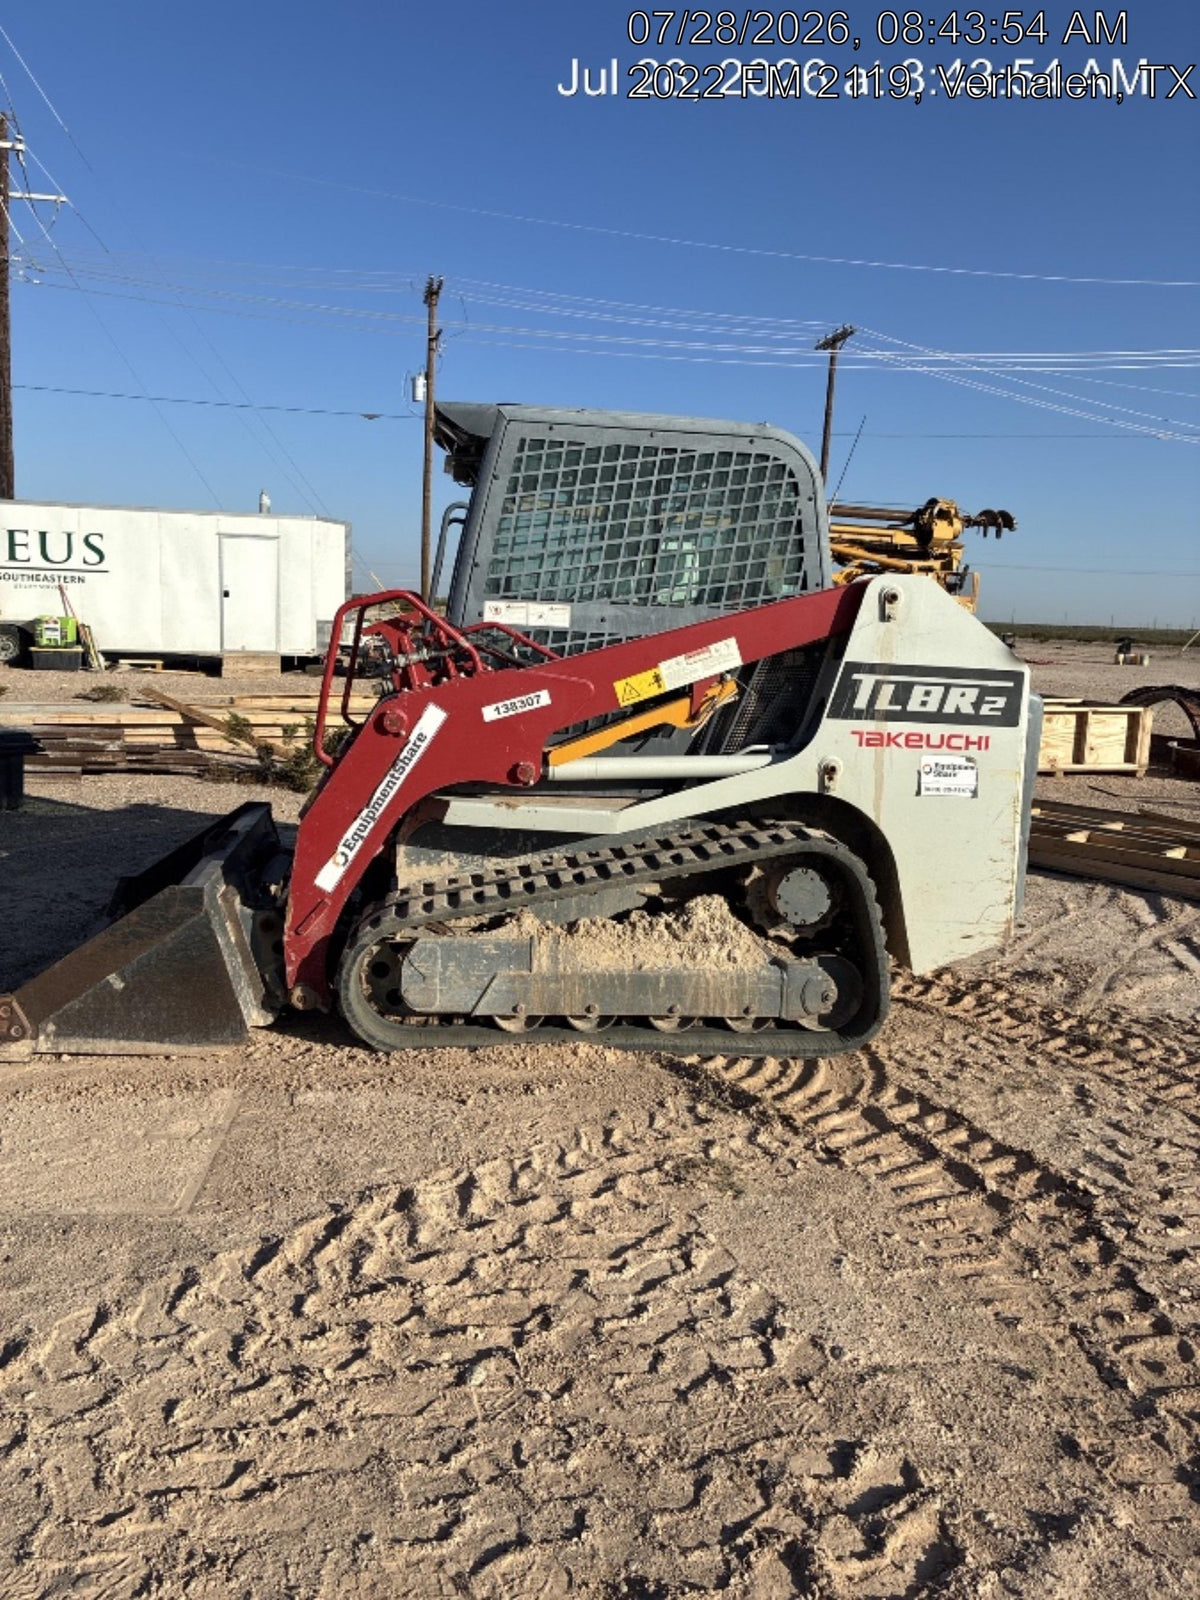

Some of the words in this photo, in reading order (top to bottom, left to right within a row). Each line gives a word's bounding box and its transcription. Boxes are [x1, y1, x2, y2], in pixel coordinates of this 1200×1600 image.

[493, 694, 541, 716] 138307
[851, 730, 990, 751] TAKEUCHI
[342, 731, 427, 852] EquipmentShare
